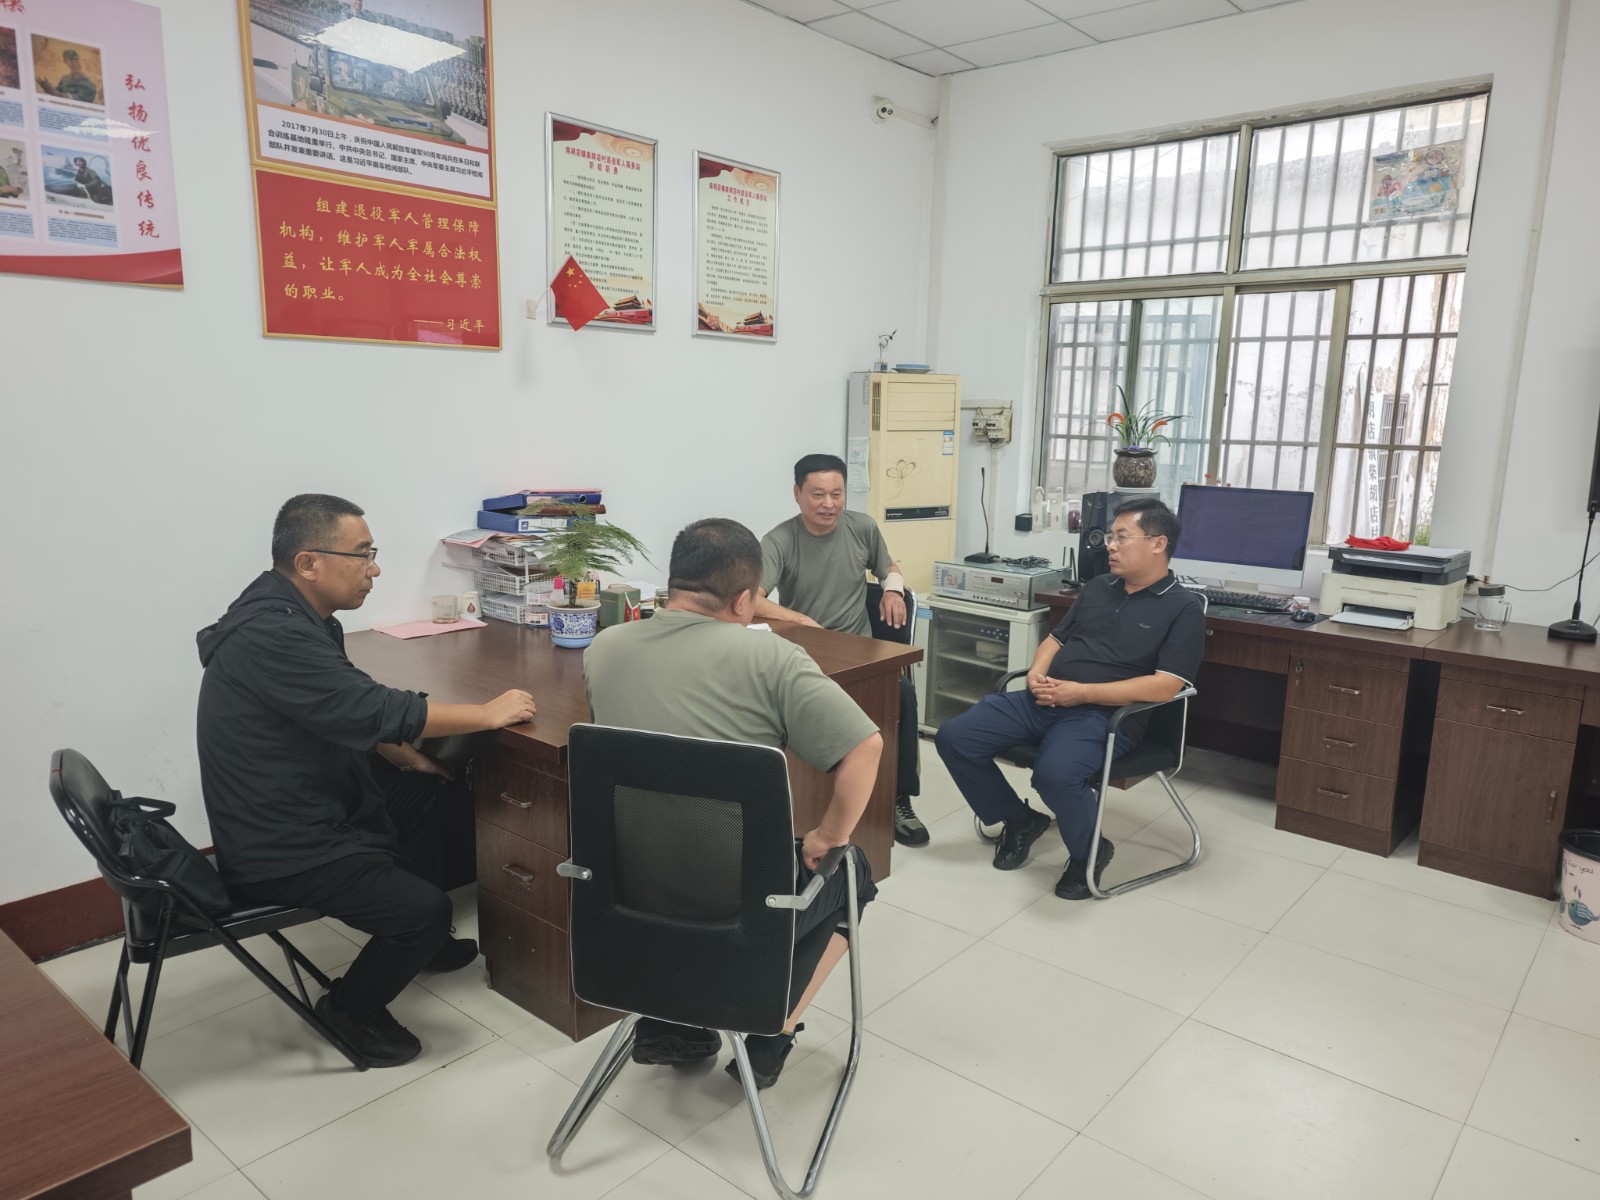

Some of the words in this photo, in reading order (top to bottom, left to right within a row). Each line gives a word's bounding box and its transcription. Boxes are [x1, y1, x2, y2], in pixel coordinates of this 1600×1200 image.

[124, 73, 160, 239] 弘扬优良传统
[316, 197, 480, 237] 组建退役军人管理保障
[279, 220, 482, 263] 机构，维护军人军属合法权
[281, 251, 482, 290] 益，让军人成为全社会尊崇
[284, 283, 345, 302] 的职业。
